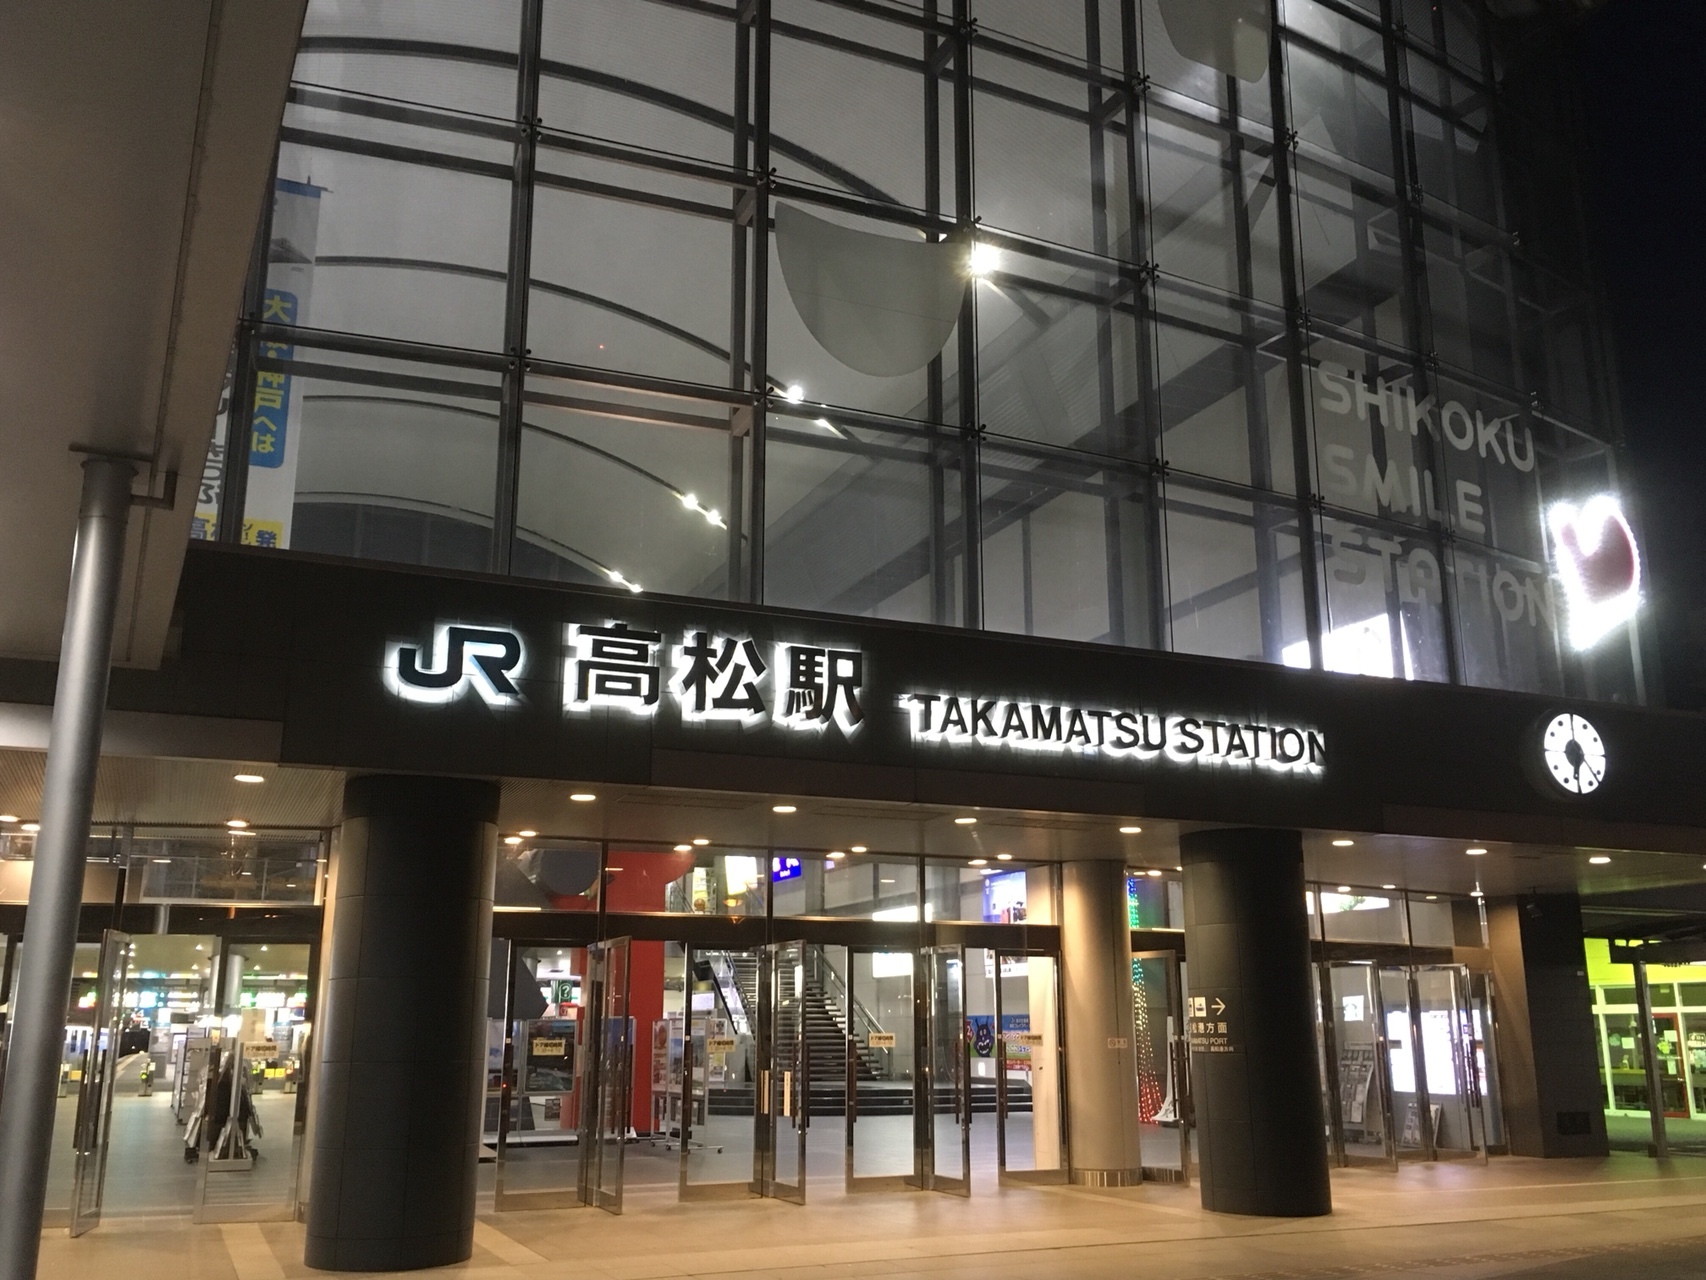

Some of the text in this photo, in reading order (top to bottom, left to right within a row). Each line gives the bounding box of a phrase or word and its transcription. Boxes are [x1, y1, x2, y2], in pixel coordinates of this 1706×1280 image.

[1318, 360, 1535, 472] SHIKOKU
[1324, 443, 1486, 533] SMILE
[1331, 528, 1556, 627] STATION
[398, 622, 865, 727] JR 高松駅
[912, 693, 1328, 766] TAKAMATSU STATION
